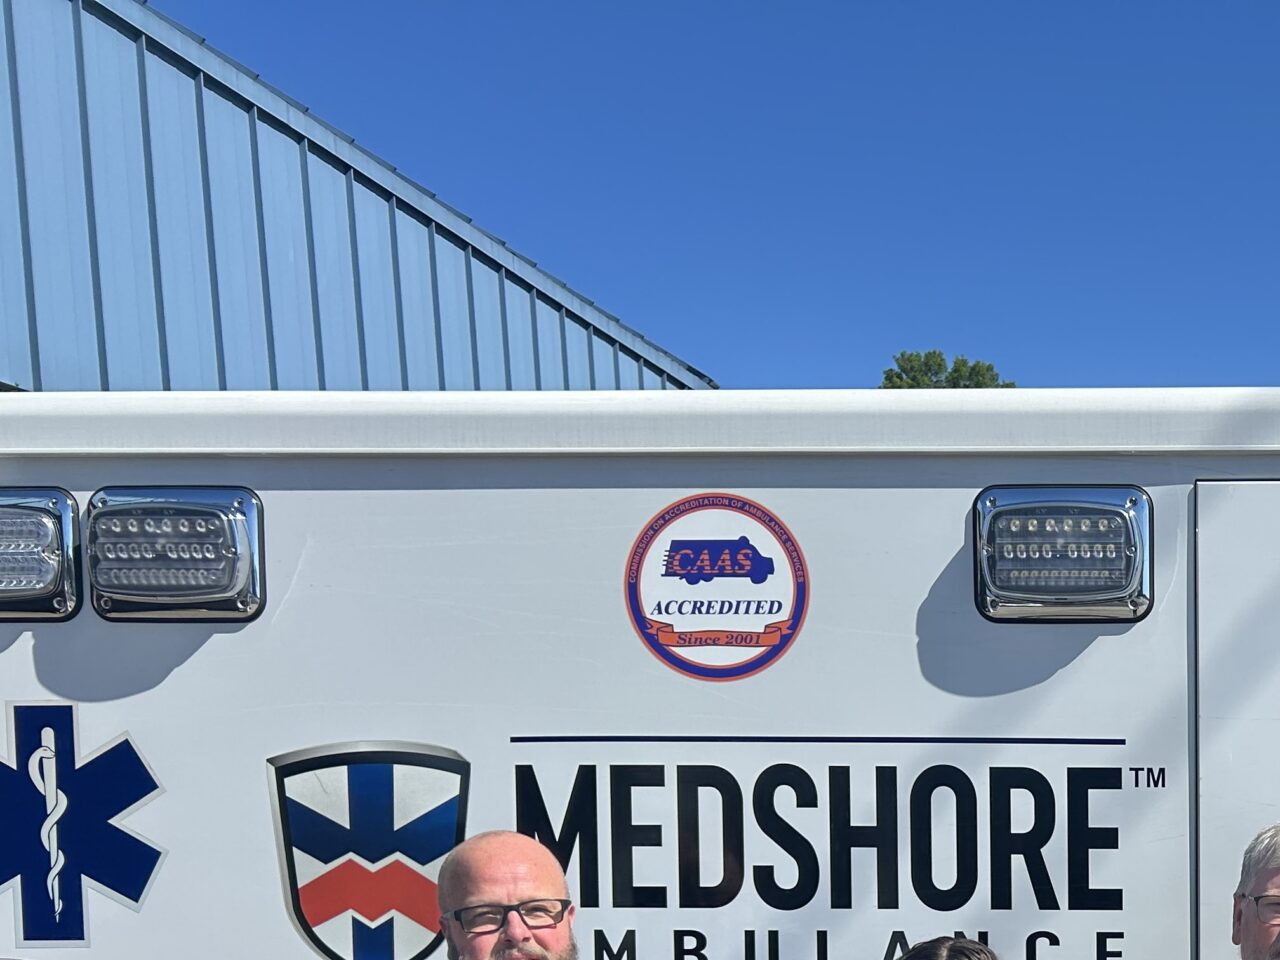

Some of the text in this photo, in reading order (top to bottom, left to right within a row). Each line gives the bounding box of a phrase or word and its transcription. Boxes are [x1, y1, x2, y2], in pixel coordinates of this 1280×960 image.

[629, 497, 804, 583] COMMISSION ON ACCREDITATION OF AMBULANCE SERVICES
[671, 549, 753, 574] CAAS
[650, 600, 783, 615] ACCREDITED
[676, 633, 761, 645] Since 2001
[514, 763, 1167, 911] MEDSHORE TM
